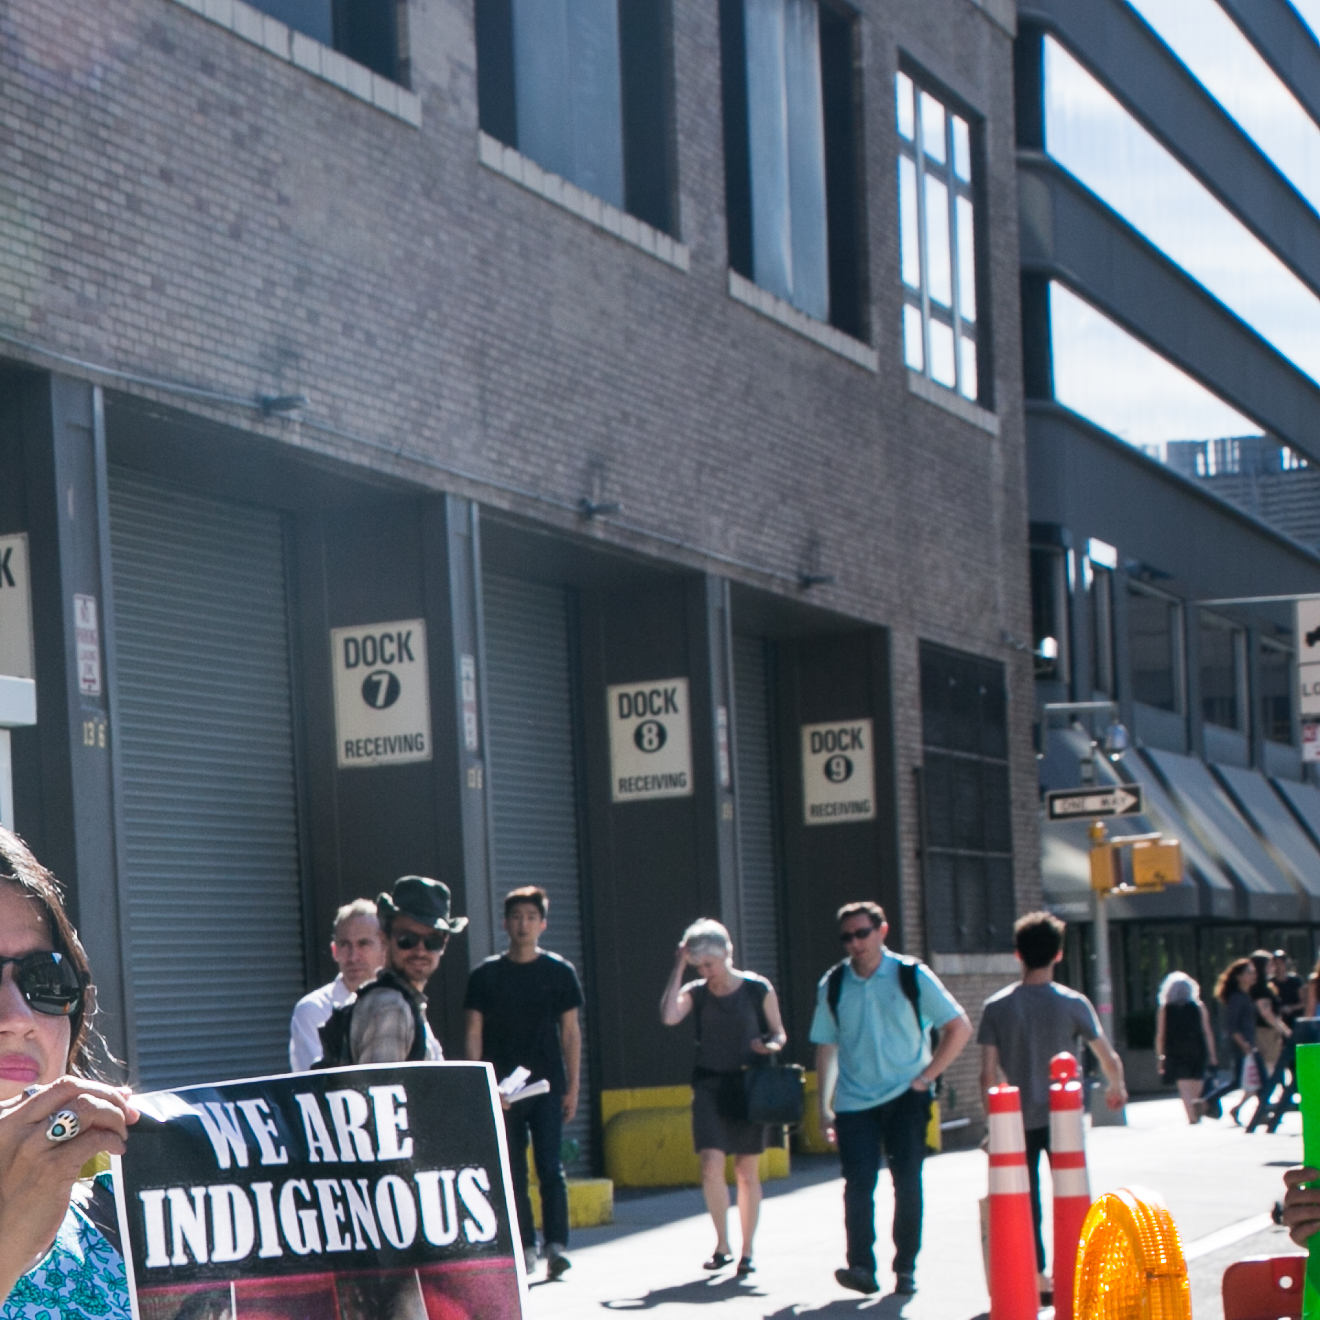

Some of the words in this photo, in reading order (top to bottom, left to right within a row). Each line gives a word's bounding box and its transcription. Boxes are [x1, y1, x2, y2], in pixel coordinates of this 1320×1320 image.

[344, 630, 414, 669] DOCK
[371, 672, 390, 708] 7
[618, 686, 678, 719] DOCK
[344, 732, 425, 758] RECEIVING
[641, 722, 659, 750] 8
[810, 726, 865, 755] DOCK
[618, 771, 687, 794] RECEIVING
[830, 758, 847, 781] 9
[810, 798, 872, 818] RECEIVING
[197, 1098, 289, 1170] WE
[294, 1083, 414, 1164] ARE
[139, 1166, 498, 1269] INDIGENOUS
